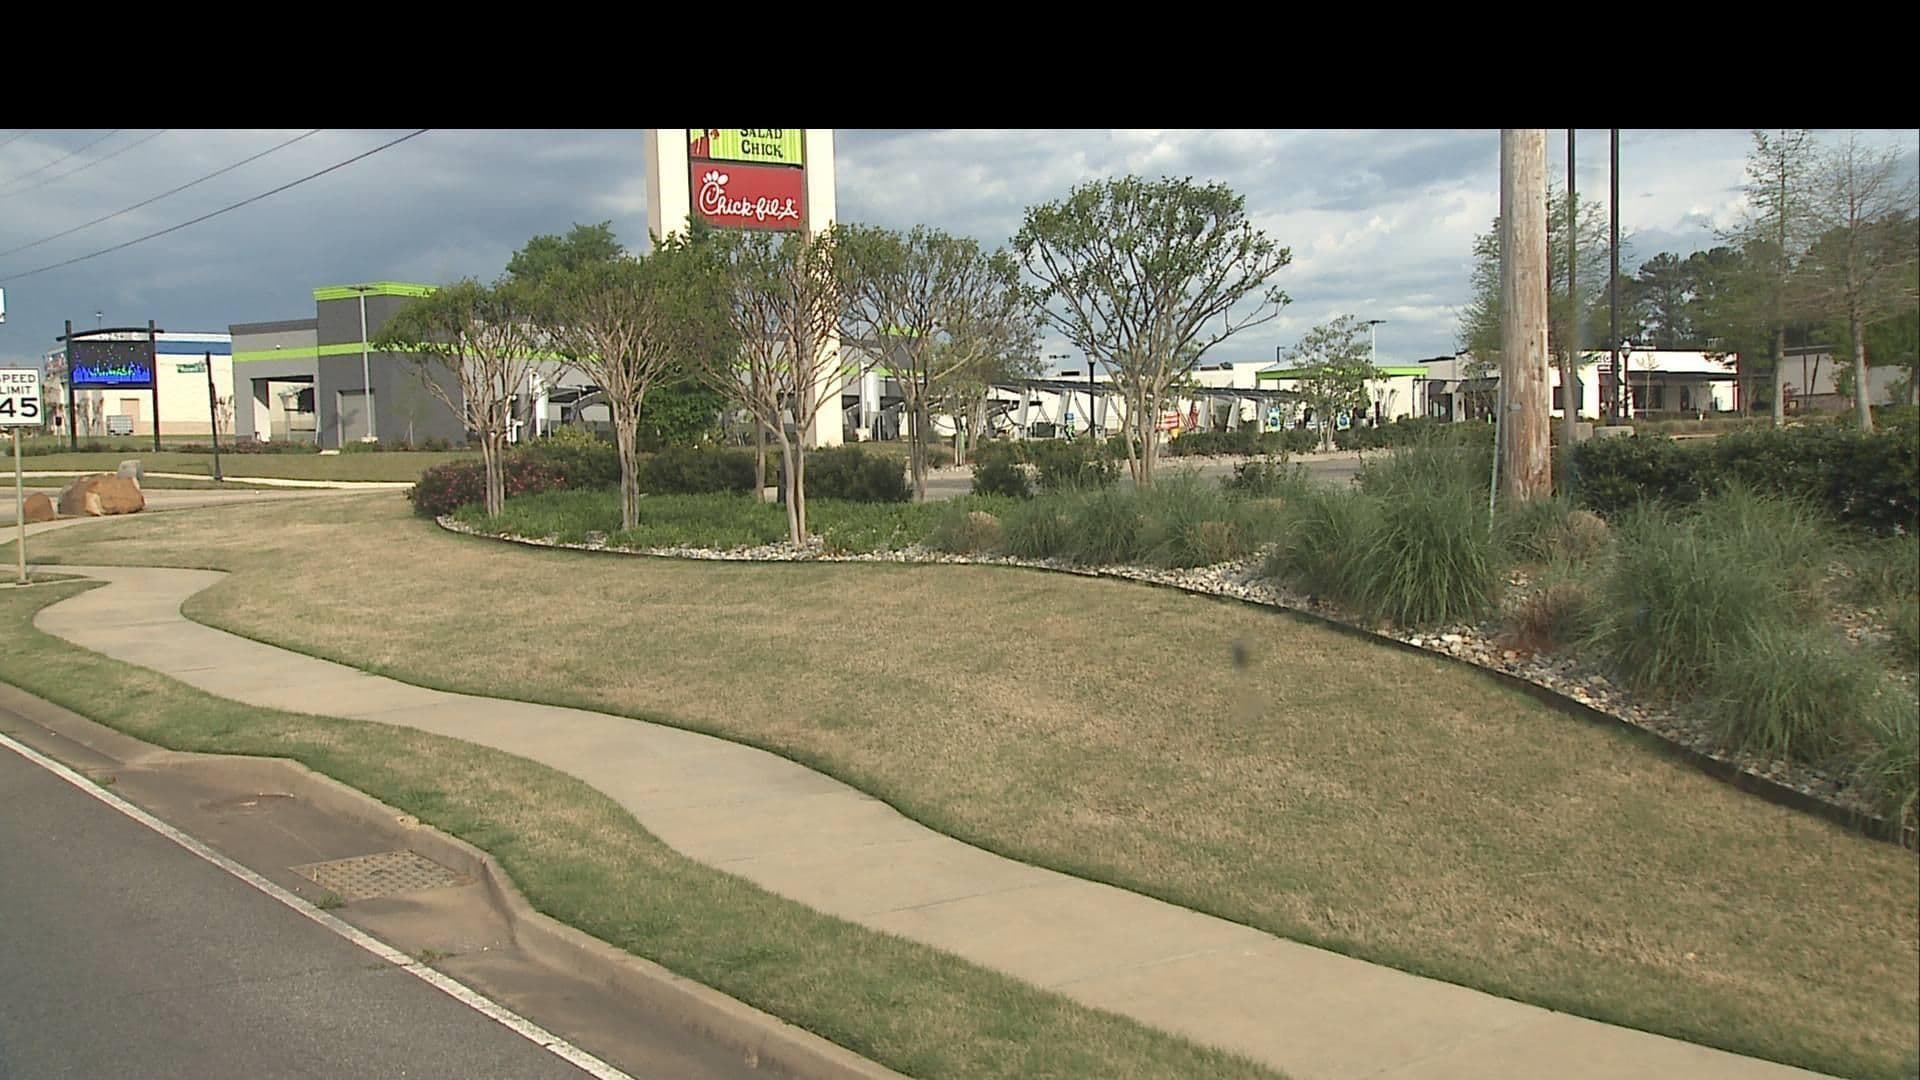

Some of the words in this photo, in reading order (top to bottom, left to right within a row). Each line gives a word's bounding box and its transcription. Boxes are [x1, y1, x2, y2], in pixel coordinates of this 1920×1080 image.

[699, 179, 799, 221] Chick-fil-A
[0, 374, 36, 383] PEED
[0, 385, 32, 395] LIMIT
[0, 397, 38, 418] 45
